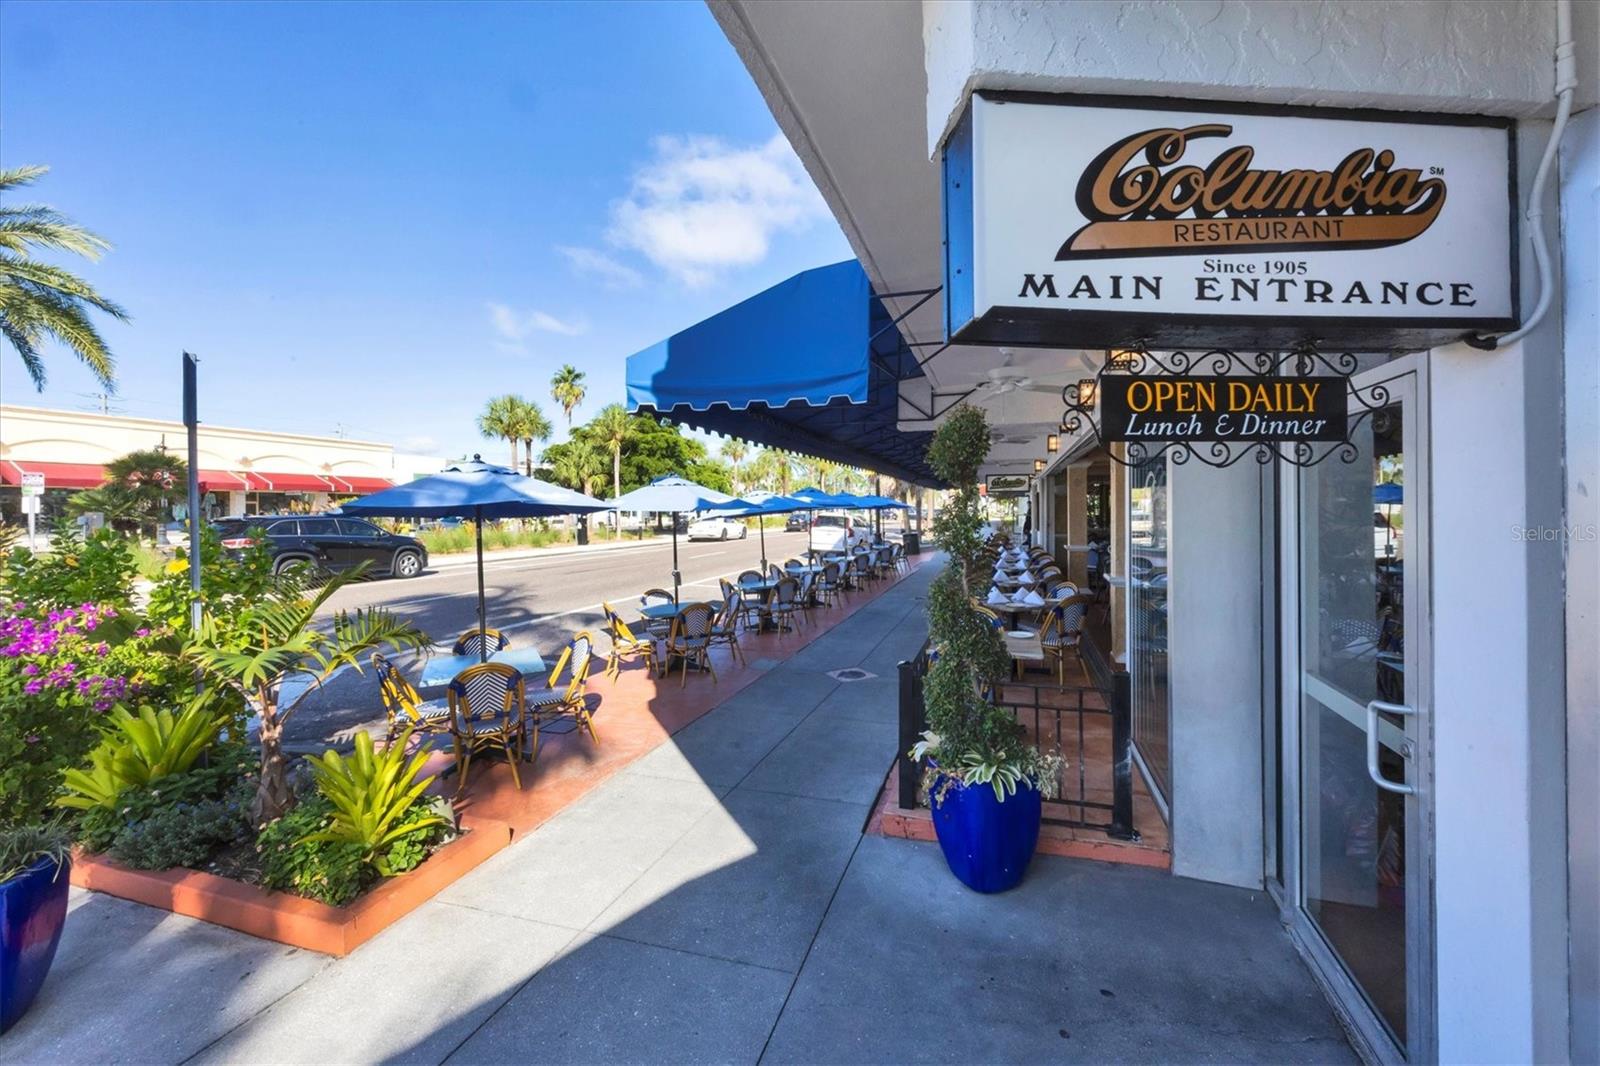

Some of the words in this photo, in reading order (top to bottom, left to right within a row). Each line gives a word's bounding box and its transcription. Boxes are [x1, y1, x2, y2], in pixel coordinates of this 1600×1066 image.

[1075, 124, 1446, 220] Columbia
[1430, 167, 1445, 175] SM
[1174, 220, 1344, 242] RESTAURANT
[1203, 259, 1256, 273] Since
[1264, 261, 1307, 275] 1905
[1018, 274, 1162, 299] MAIN
[1195, 277, 1476, 307] ENTRANCE
[1127, 381, 1215, 412] OPEN
[1228, 382, 1320, 412] DAILY
[1125, 413, 1202, 436] Lunch
[1215, 413, 1234, 436] &
[1240, 413, 1326, 436] Dinner
